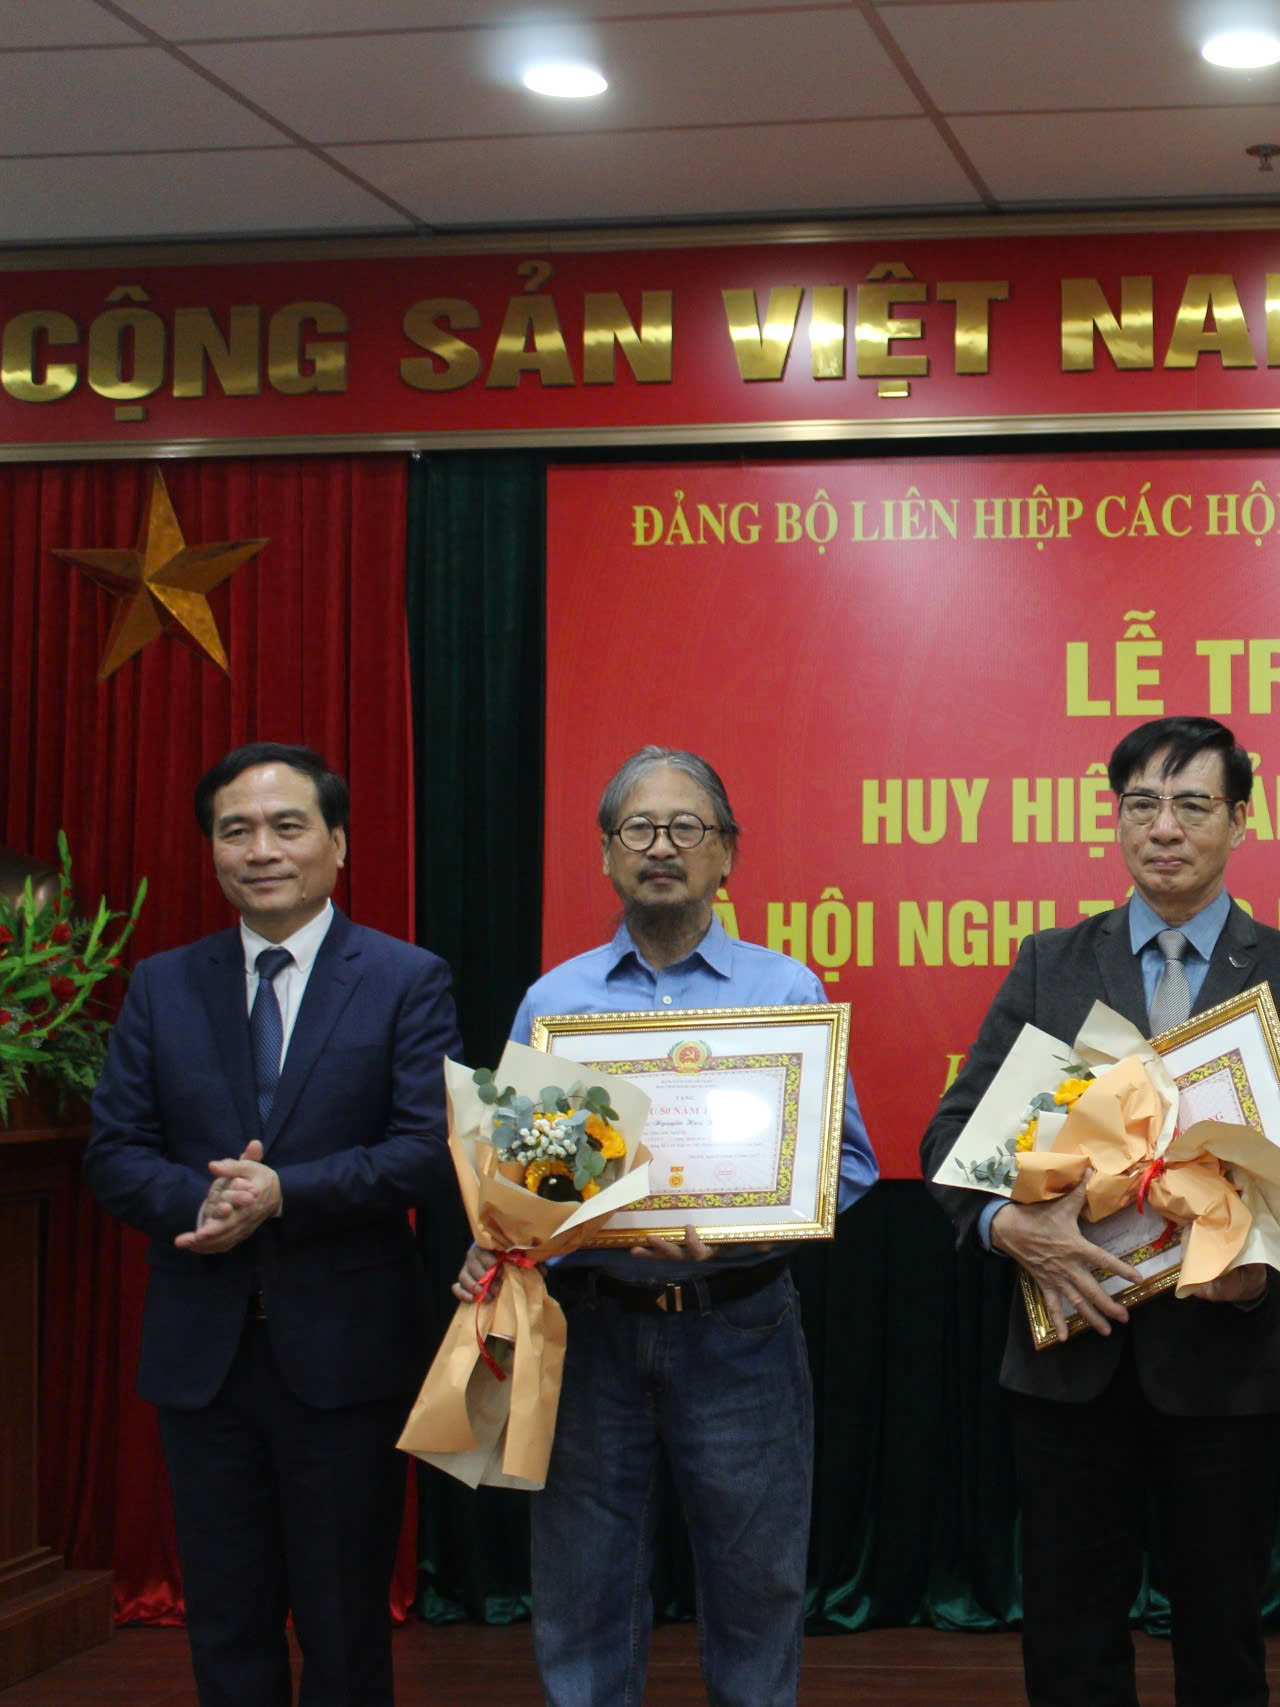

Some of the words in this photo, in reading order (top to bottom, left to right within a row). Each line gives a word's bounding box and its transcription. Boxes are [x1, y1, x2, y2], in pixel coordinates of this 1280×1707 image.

[1, 285, 350, 421] CỘNG
[399, 260, 674, 392] SẢN
[722, 261, 1011, 397] VIỆT
[632, 490, 762, 546] ĐẢNG
[775, 488, 839, 553] BỘ
[853, 486, 959, 542] LIÊN
[974, 484, 1084, 550] HIỆP
[1095, 482, 1193, 538] CÁC
[1064, 610, 1165, 718] LỄ
[861, 777, 990, 847] HUY
[1010, 763, 1118, 859] HIỆ
[766, 886, 874, 983] HỘI
